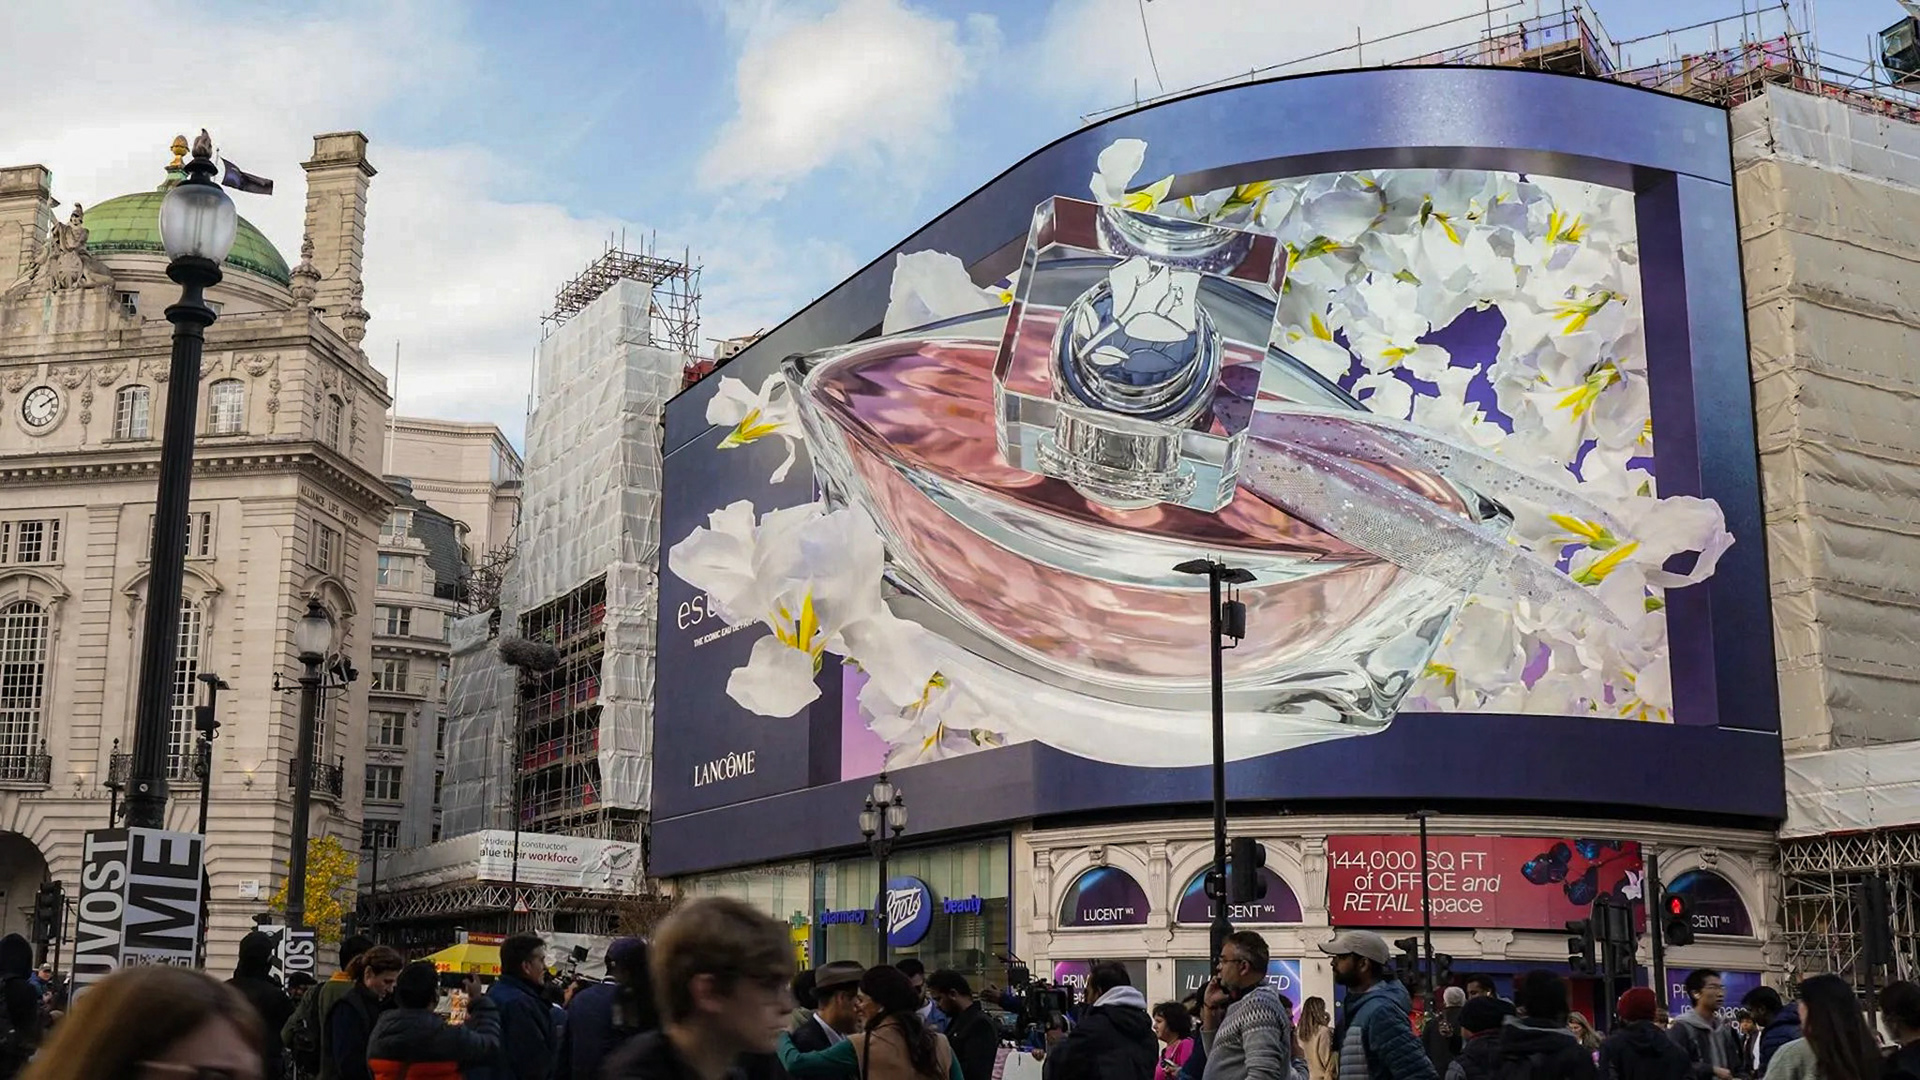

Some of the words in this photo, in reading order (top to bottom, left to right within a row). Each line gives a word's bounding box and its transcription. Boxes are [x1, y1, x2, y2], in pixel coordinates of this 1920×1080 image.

[301, 485, 324, 507] ALLIANCE
[328, 500, 339, 515] LIFE
[342, 510, 358, 527] OFFICE
[694, 637, 704, 647] THE
[704, 630, 721, 643] ICONIC
[695, 751, 755, 787] LANCÔME
[521, 841, 568, 851] constructors
[528, 852, 578, 864] workforce
[1329, 851, 1416, 872] 144,000
[1426, 851, 1455, 871] SQ
[1461, 852, 1487, 871] FT
[1354, 873, 1373, 891] of
[1379, 872, 1456, 891] OFFCE
[1461, 874, 1501, 892] and
[125, 835, 201, 951] ME
[1343, 893, 1415, 912] RETAIL
[943, 895, 983, 916] beauty
[1084, 908, 1123, 921] LUCENT
[1208, 905, 1261, 918] LCENT
[819, 908, 867, 928] pharmacy
[1692, 915, 1719, 928] CENT
